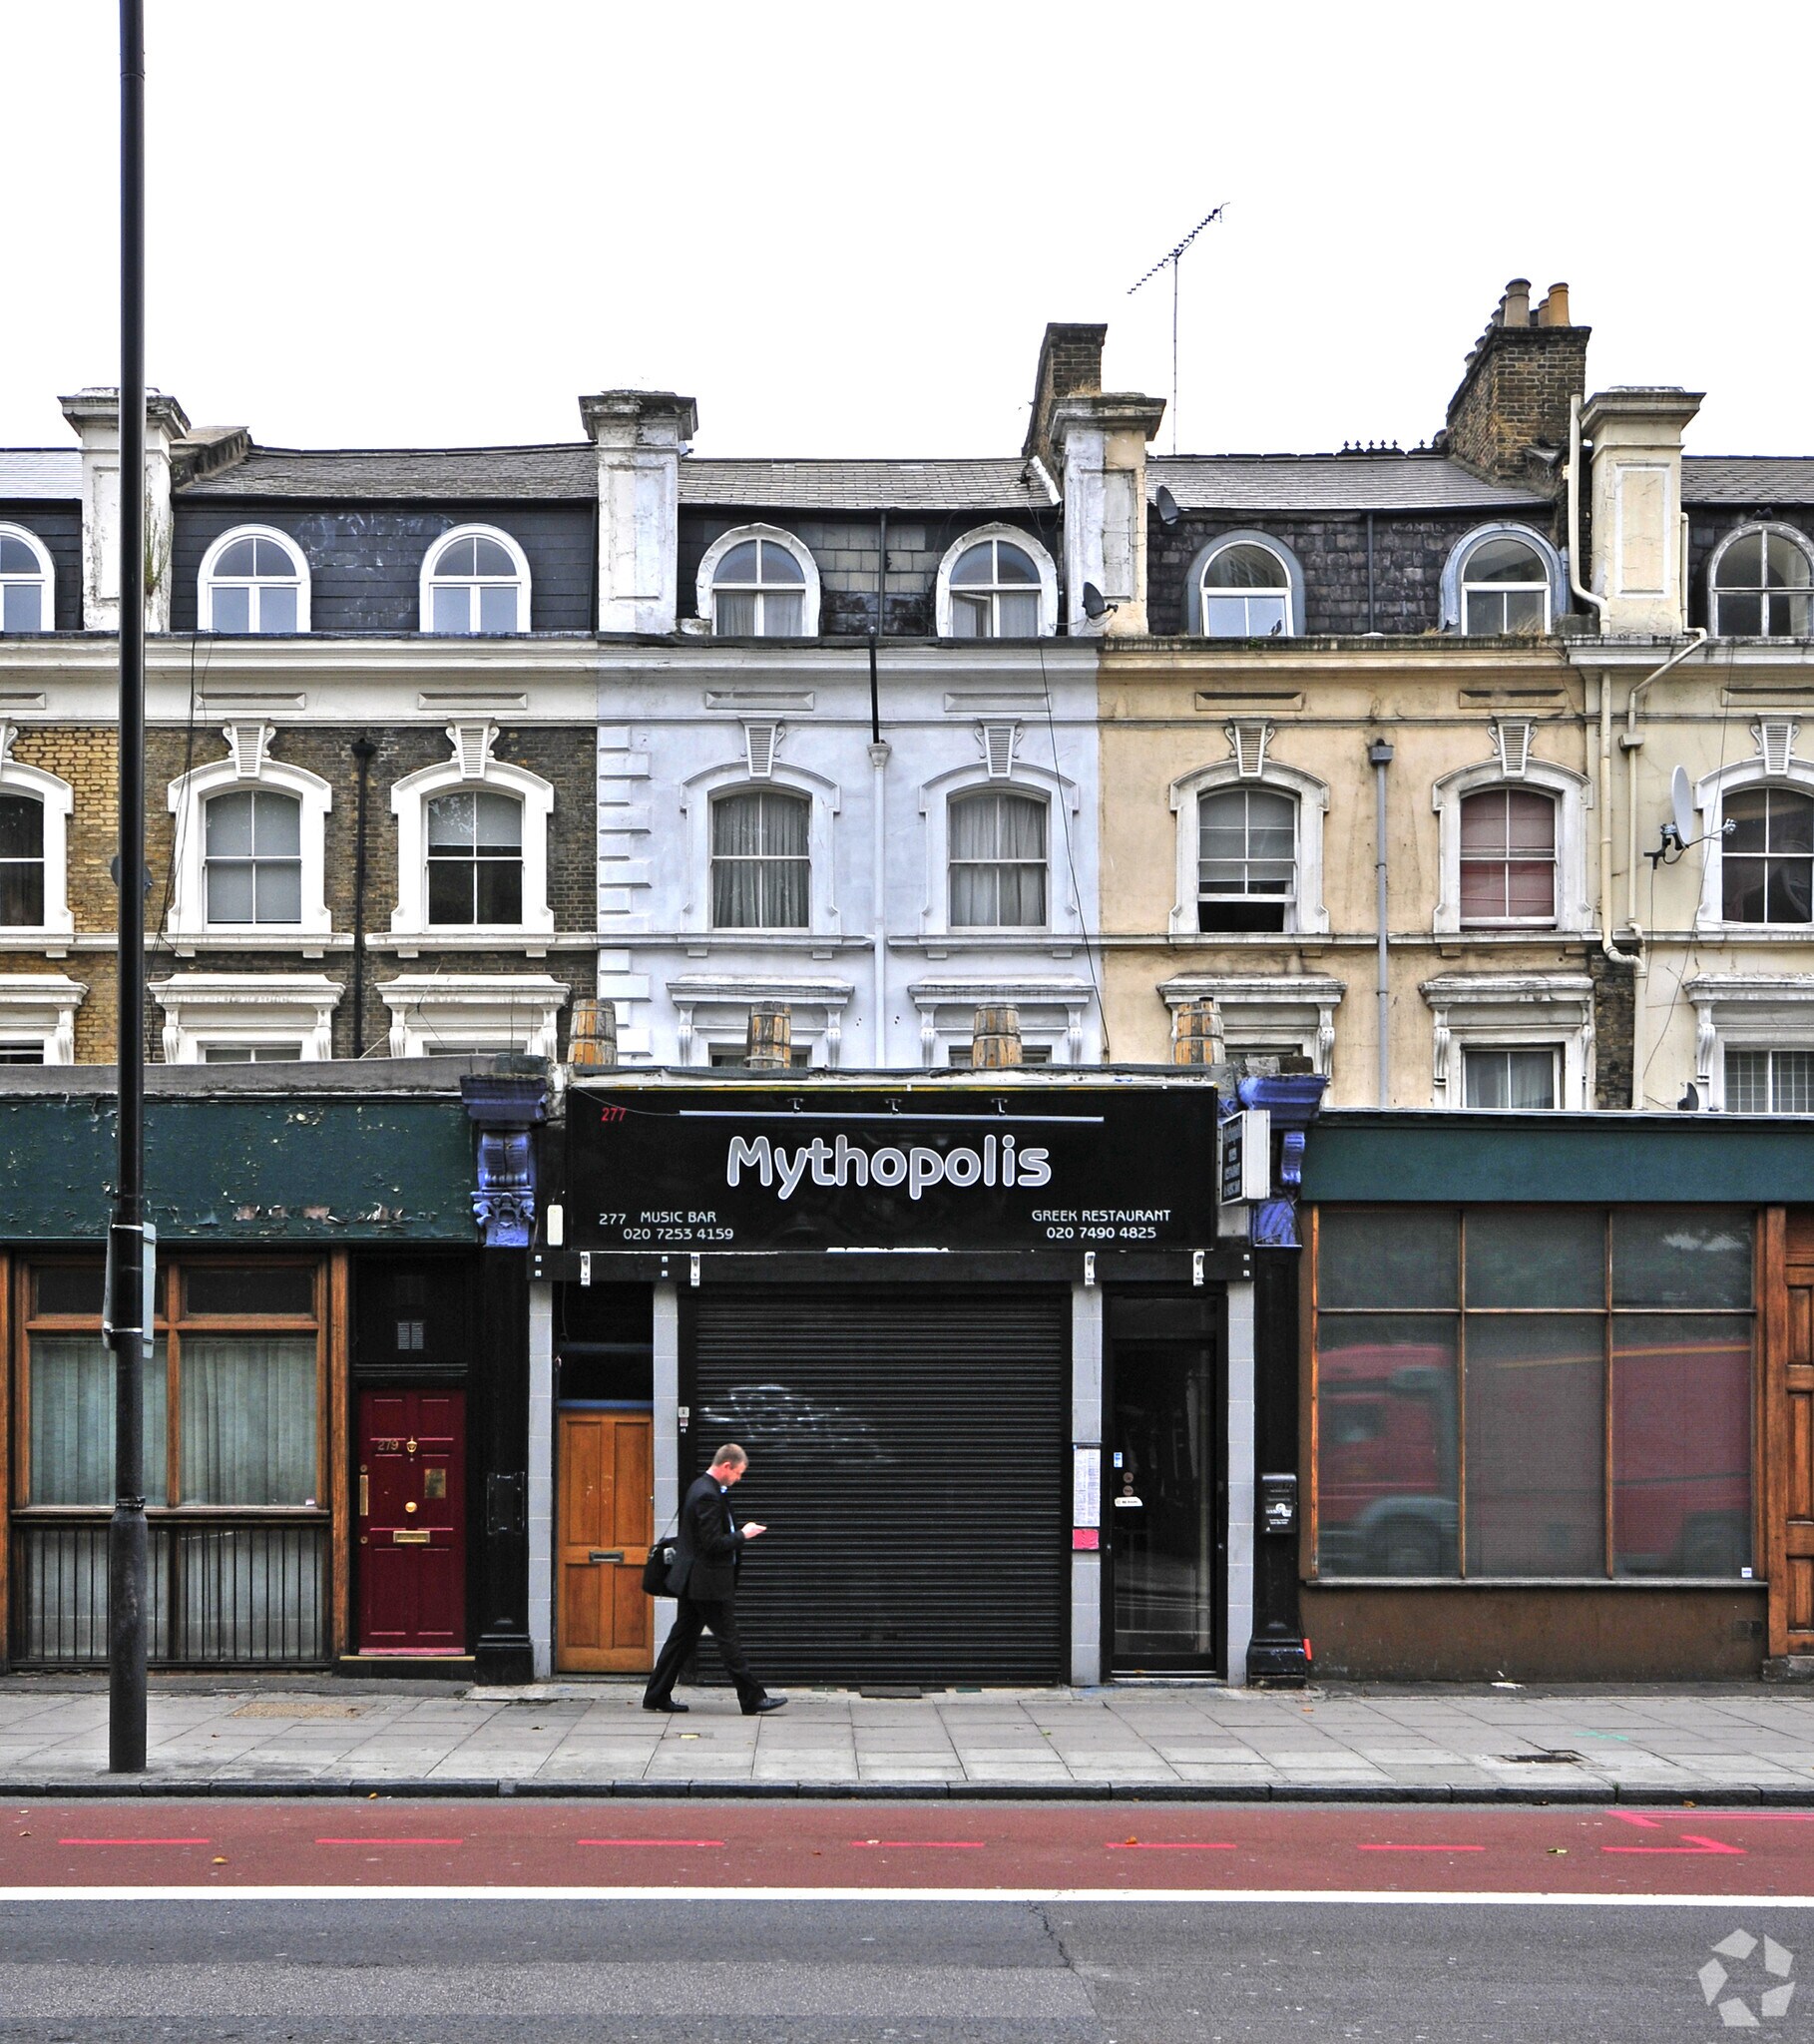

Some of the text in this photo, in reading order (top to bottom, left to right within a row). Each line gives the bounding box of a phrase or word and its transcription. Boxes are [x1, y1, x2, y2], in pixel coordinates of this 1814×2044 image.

[602, 1107, 626, 1122] 277
[726, 1134, 1052, 1200] Mythopolis
[599, 1211, 716, 1225] 277 MUSIC BAR
[1031, 1210, 1171, 1222] GREEK RESTAURANT
[623, 1228, 734, 1241] 020 7253 4159
[1046, 1227, 1157, 1240] 020 7490 4825
[378, 1439, 399, 1450] 279
